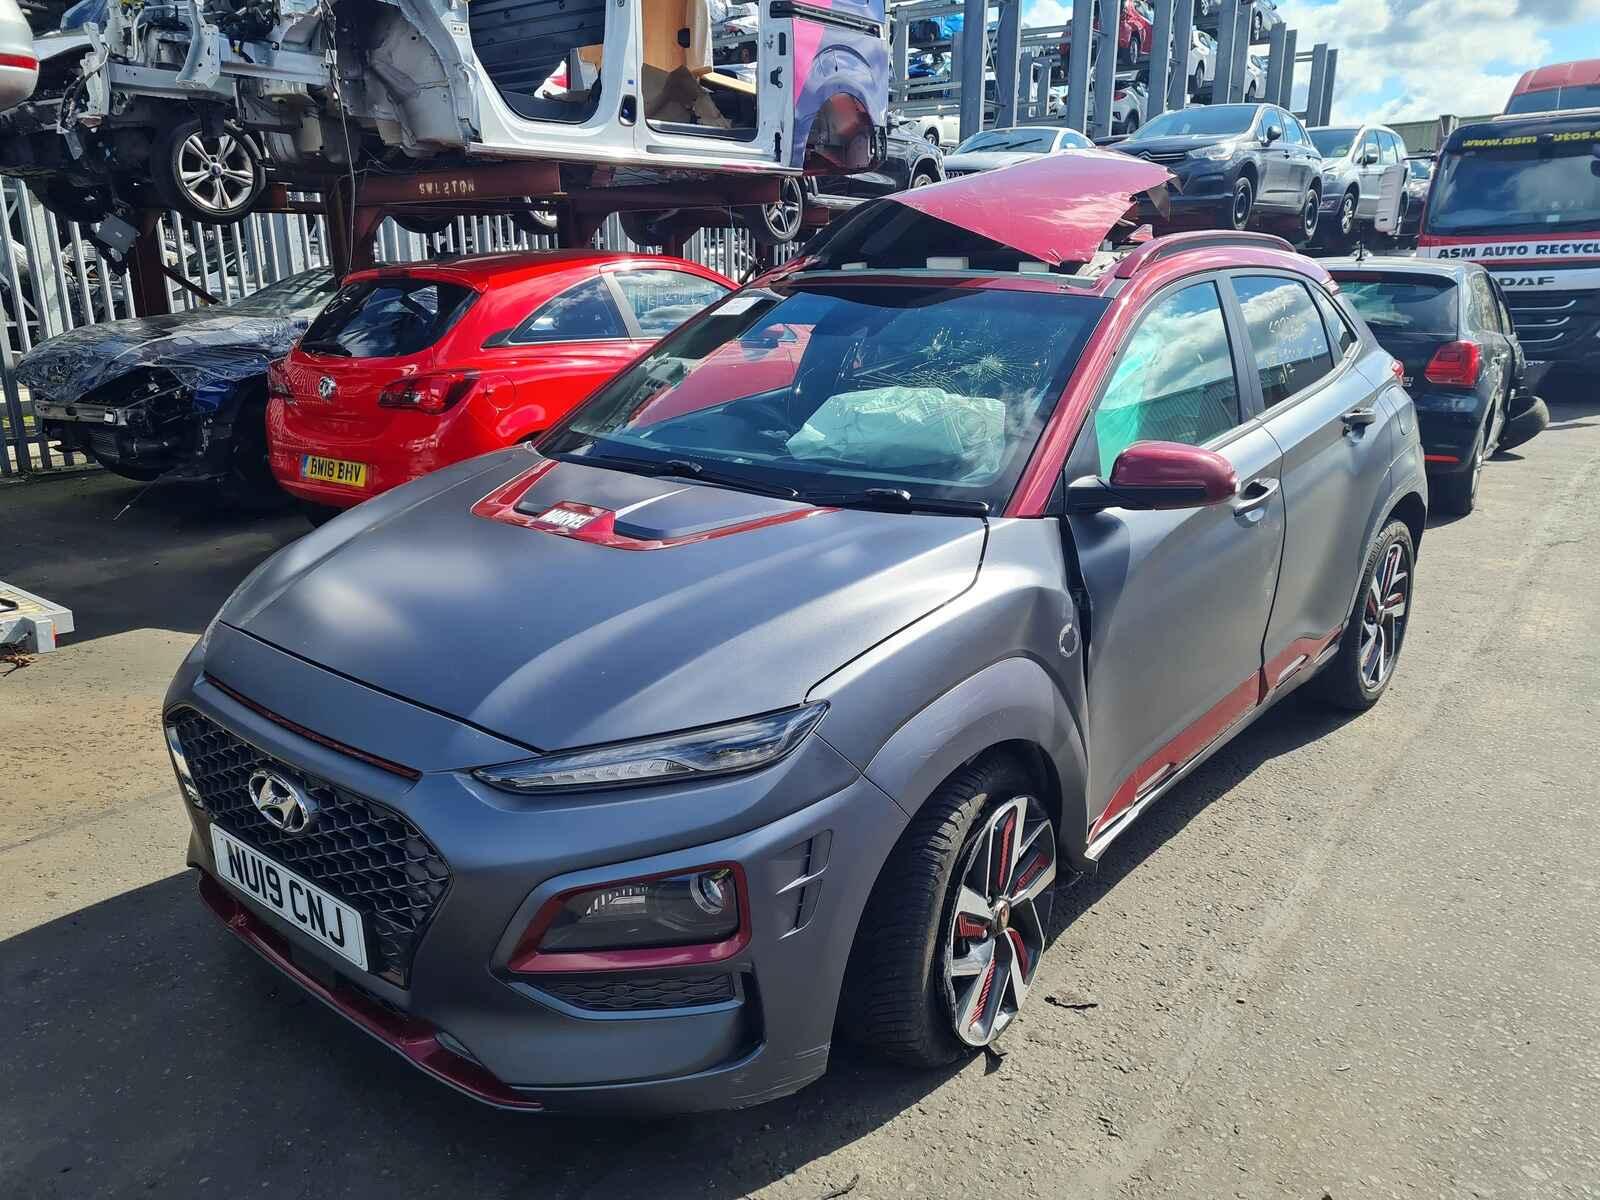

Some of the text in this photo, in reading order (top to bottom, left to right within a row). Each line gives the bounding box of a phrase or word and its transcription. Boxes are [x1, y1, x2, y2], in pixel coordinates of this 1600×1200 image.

[1437, 247, 1476, 259] ASM
[1481, 245, 1529, 257] AUTO
[1500, 276, 1555, 286] DAF
[310, 458, 361, 482] BW18 BHV
[538, 508, 597, 529] MARVEL
[225, 840, 345, 947] NU19 CNJ
